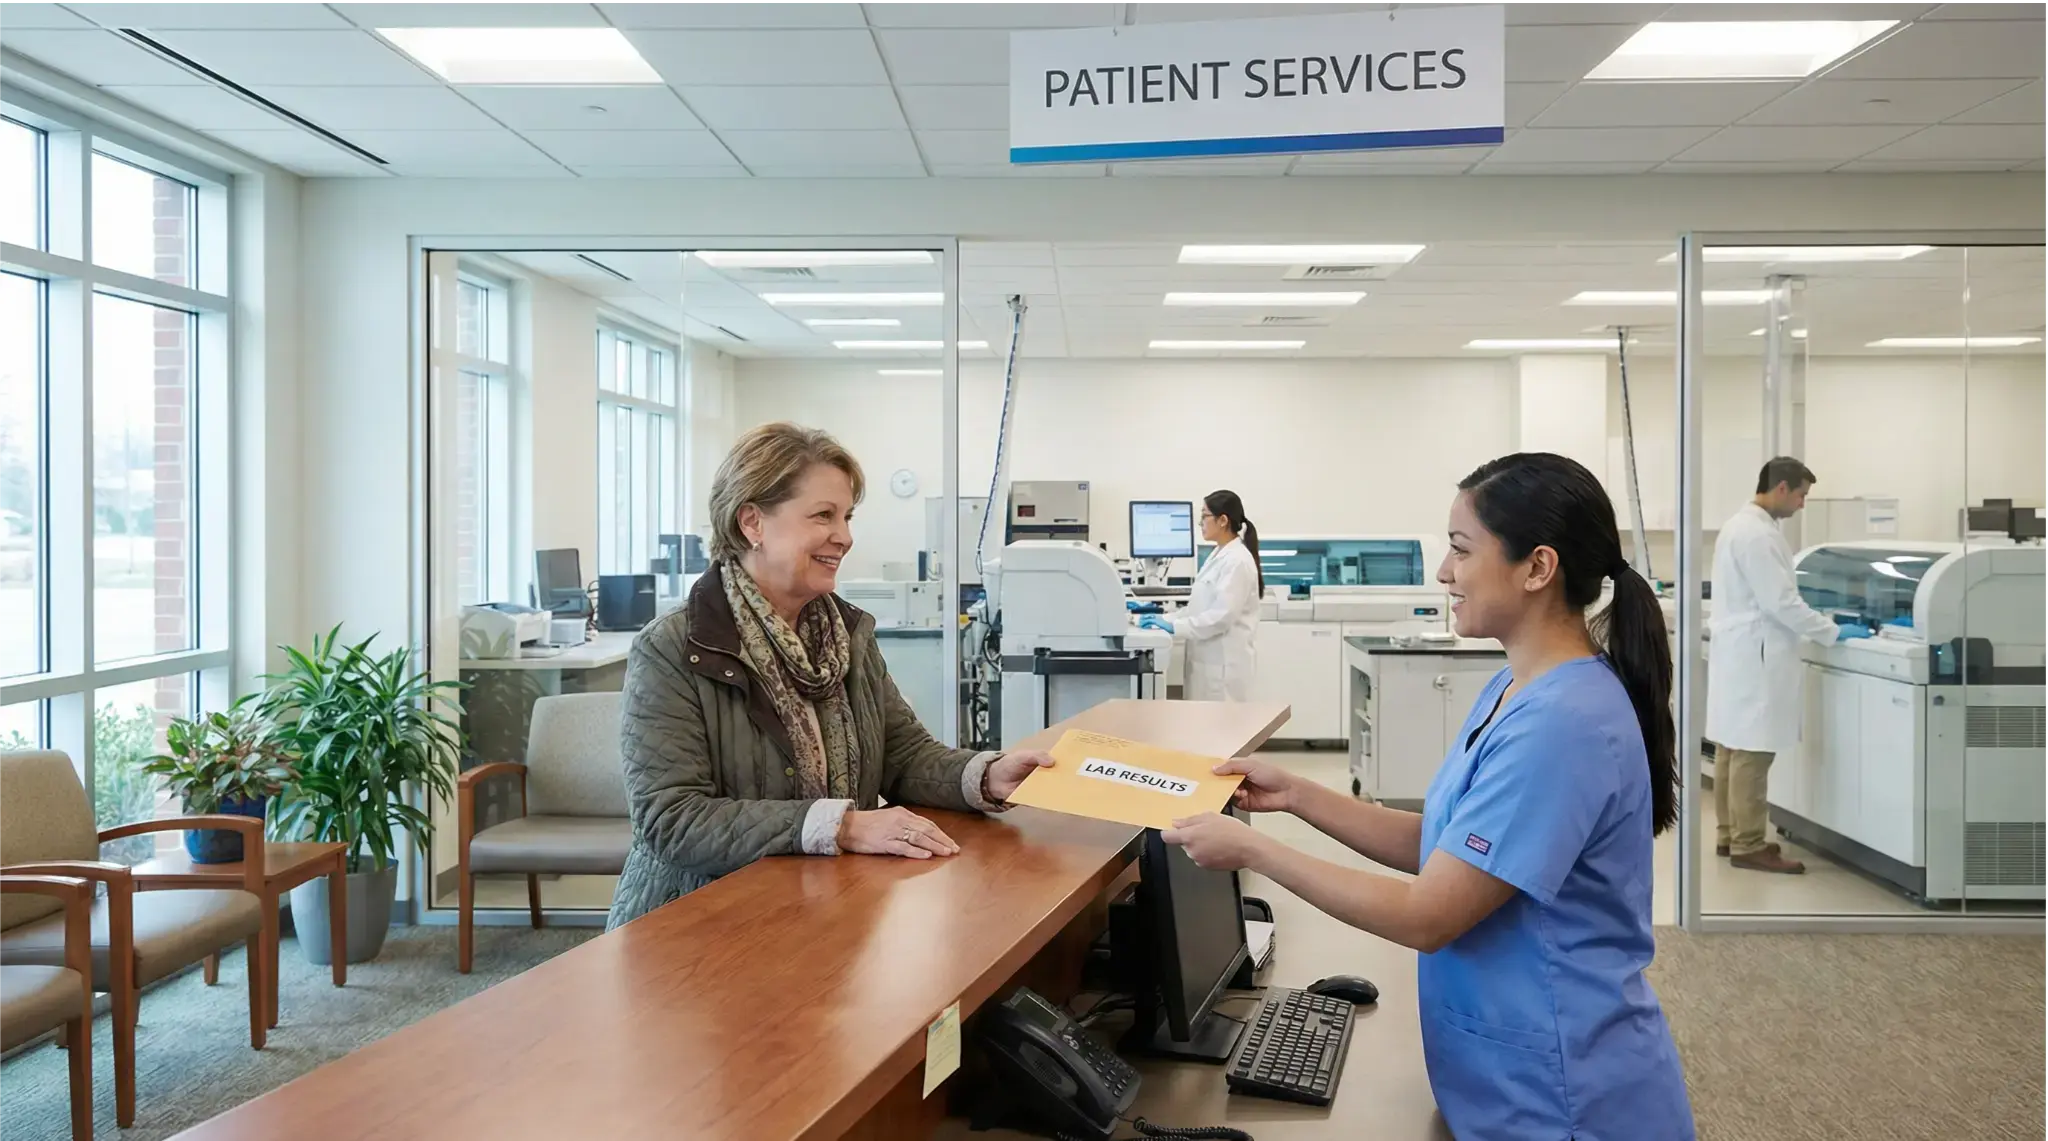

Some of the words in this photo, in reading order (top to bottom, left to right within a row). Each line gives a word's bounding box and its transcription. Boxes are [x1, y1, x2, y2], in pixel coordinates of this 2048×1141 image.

[1046, 61, 1230, 107] PATIENT
[1244, 49, 1466, 98] SERVICES
[1085, 763, 1117, 776] LAB
[1119, 770, 1188, 792] RESULTS
